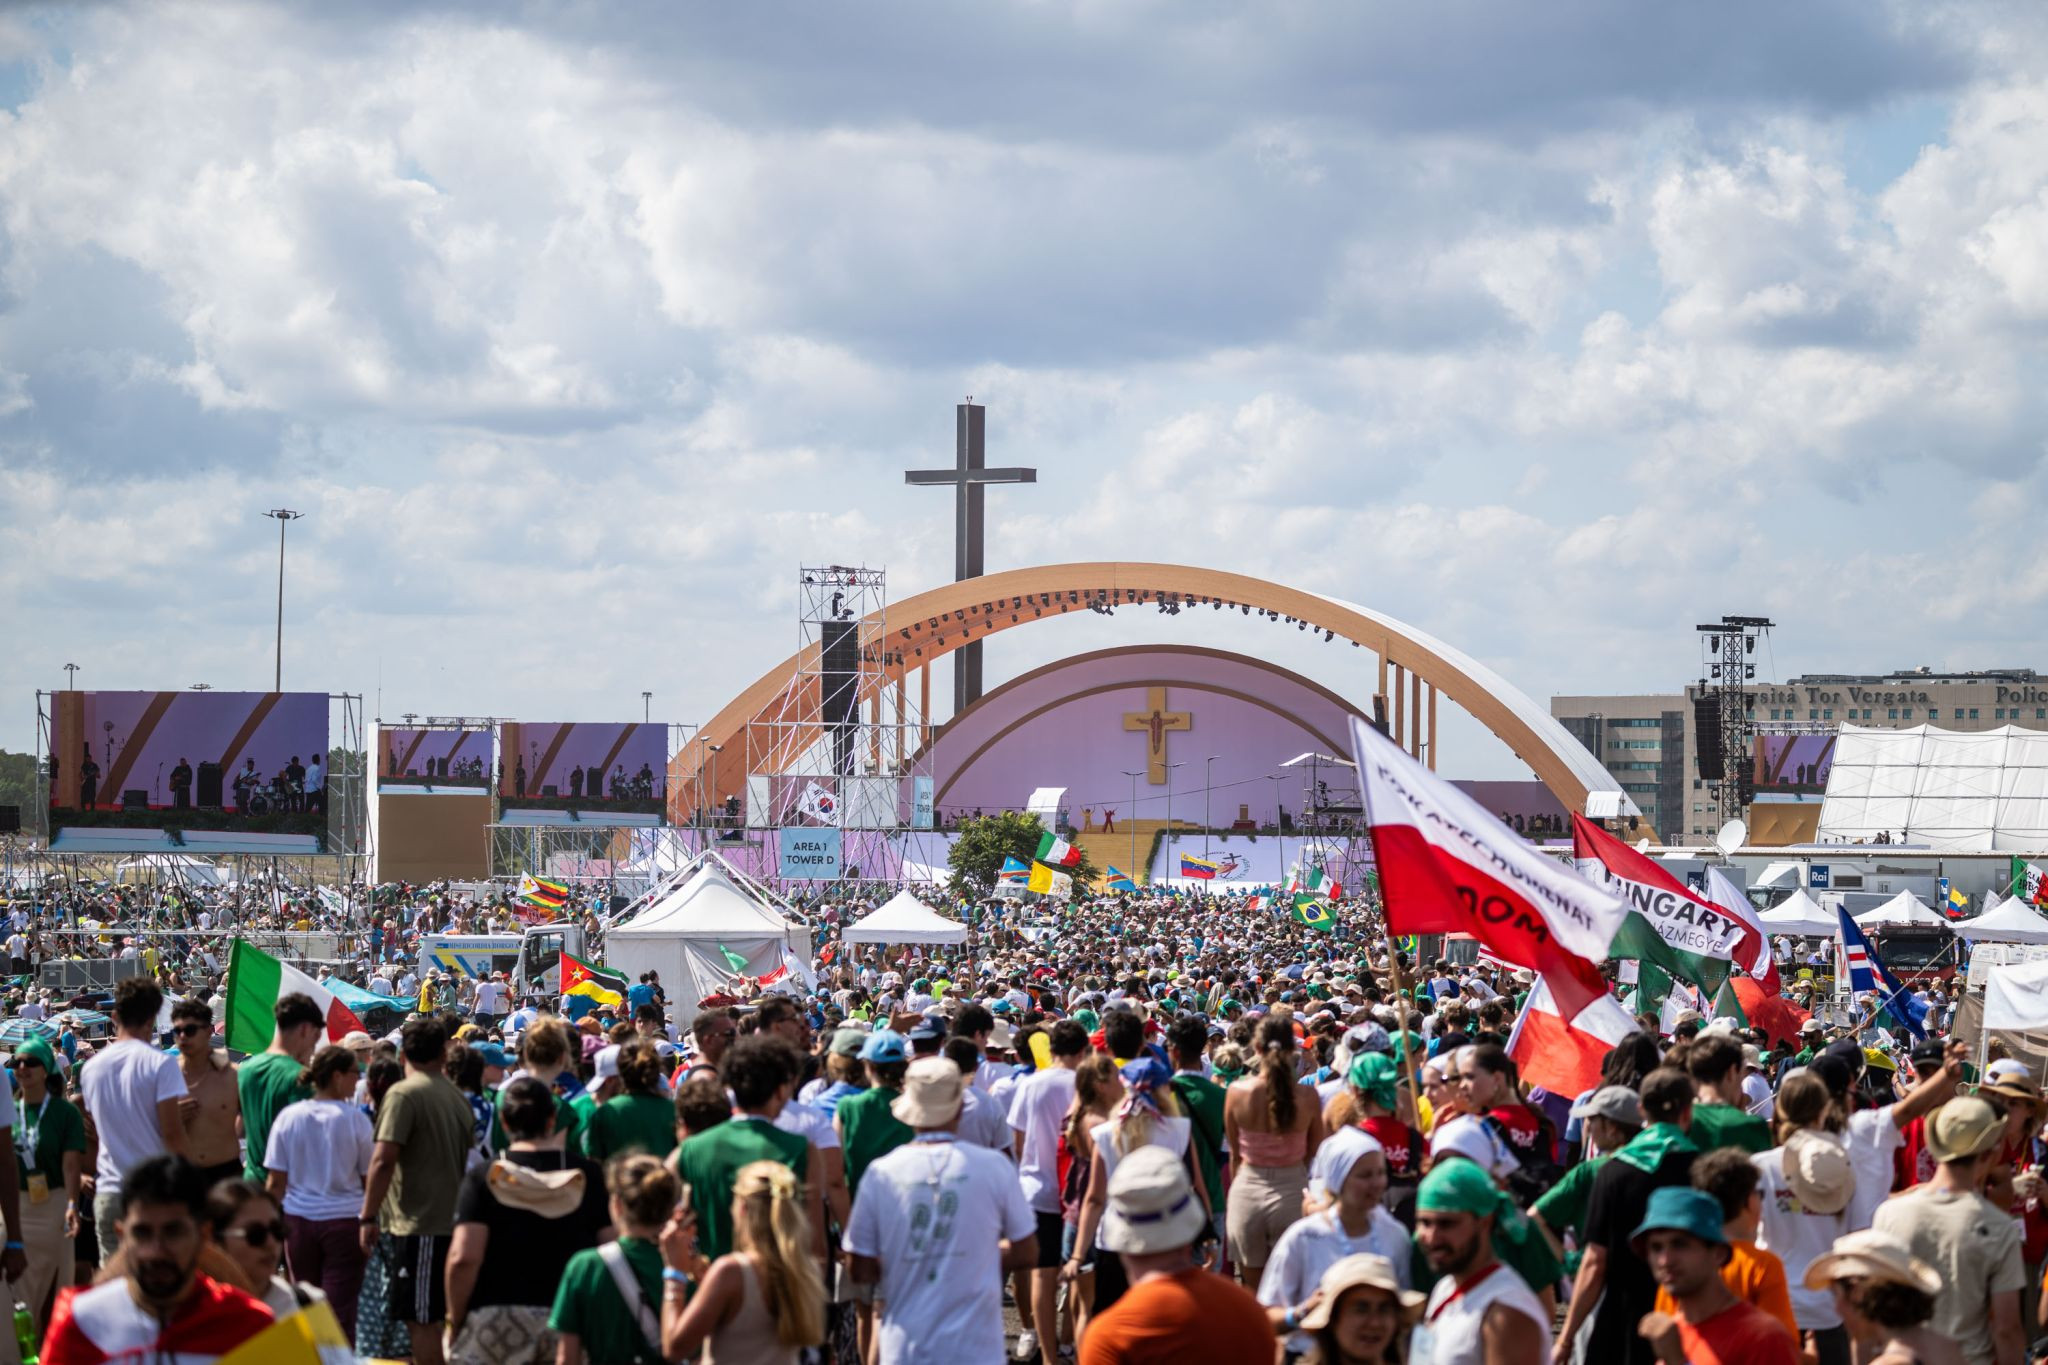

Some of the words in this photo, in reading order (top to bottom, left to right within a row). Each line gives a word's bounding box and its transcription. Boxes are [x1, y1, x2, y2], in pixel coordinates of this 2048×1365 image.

[1689, 687, 1797, 704] Usità
[1805, 686, 1841, 704] Tor
[1847, 686, 1929, 706] Vergata
[1996, 686, 2048, 703] Polic
[793, 842, 821, 851] AREA
[822, 842, 827, 851] 1
[786, 855, 823, 864] TOWER
[826, 855, 834, 864] D
[1811, 870, 1828, 882] Rai
